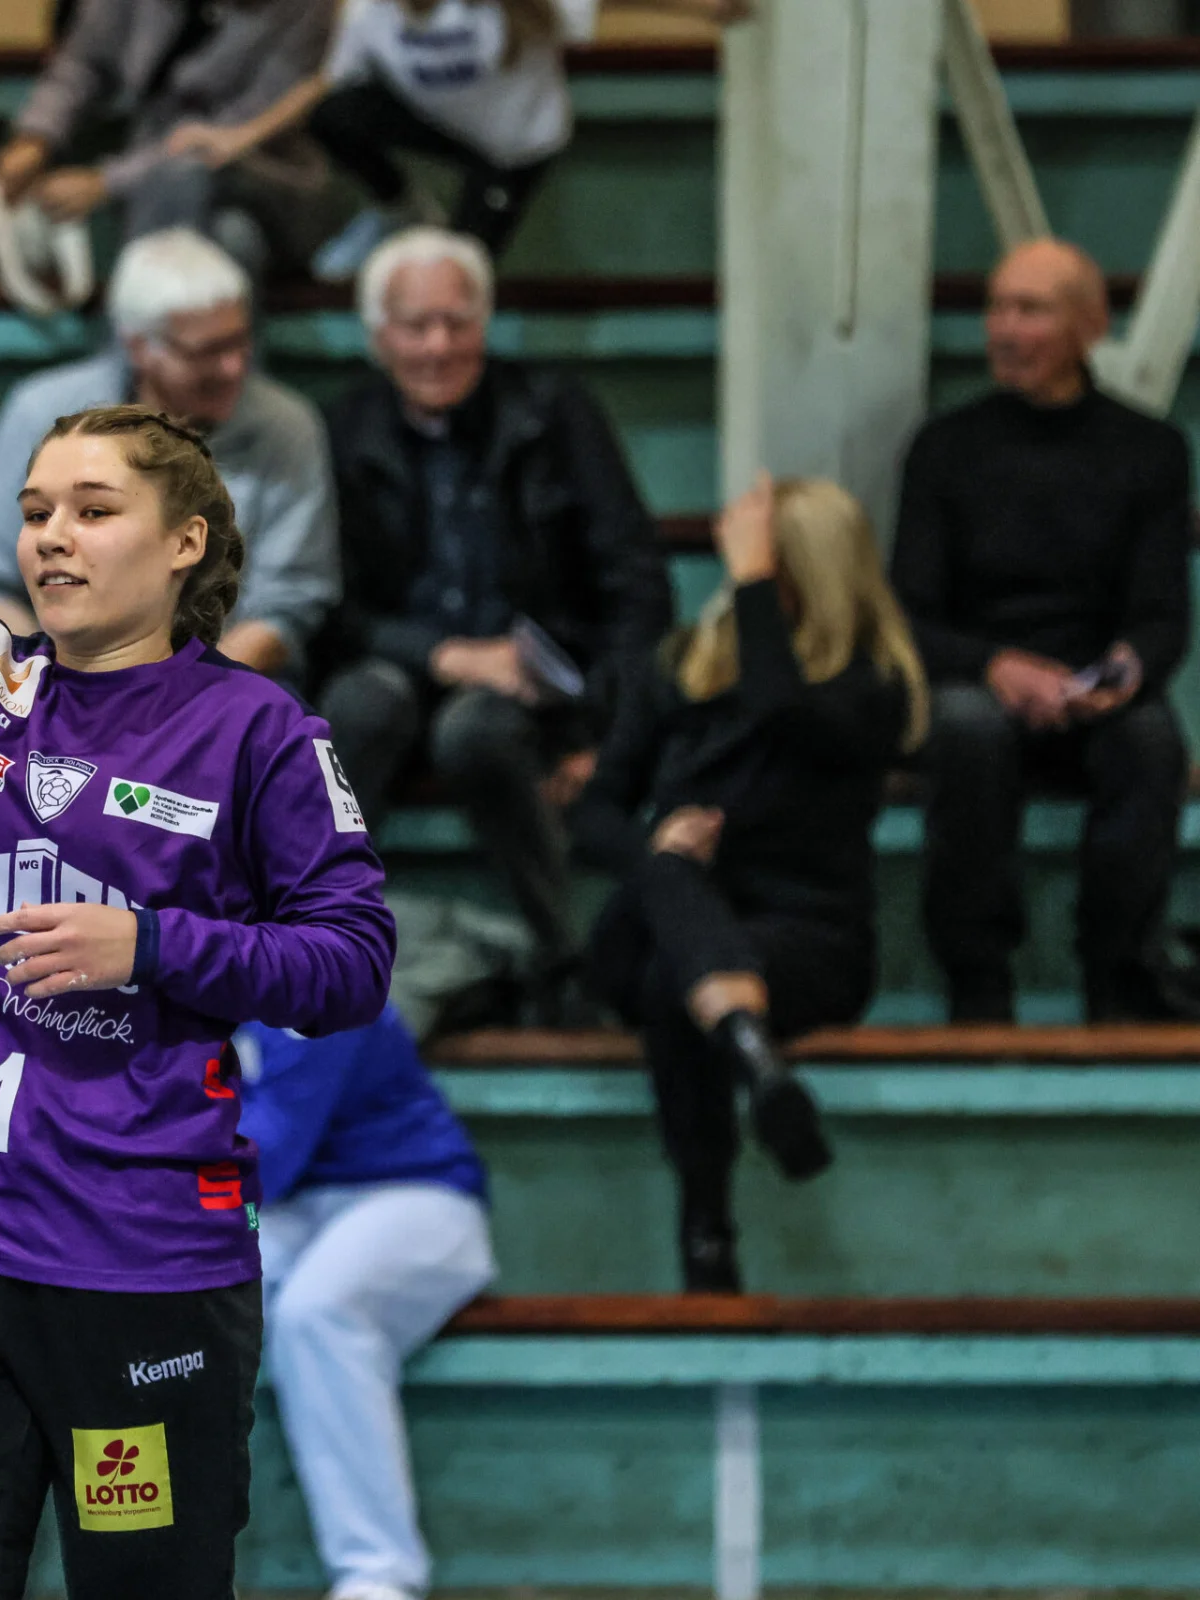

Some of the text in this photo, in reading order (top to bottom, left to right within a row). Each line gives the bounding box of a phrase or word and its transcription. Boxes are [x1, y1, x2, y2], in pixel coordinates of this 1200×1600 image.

[63, 759, 92, 772] DOLPHINS
[18, 860, 39, 870] WG
[129, 1349, 204, 1386] Kempa
[85, 1482, 159, 1505] LOTTO
